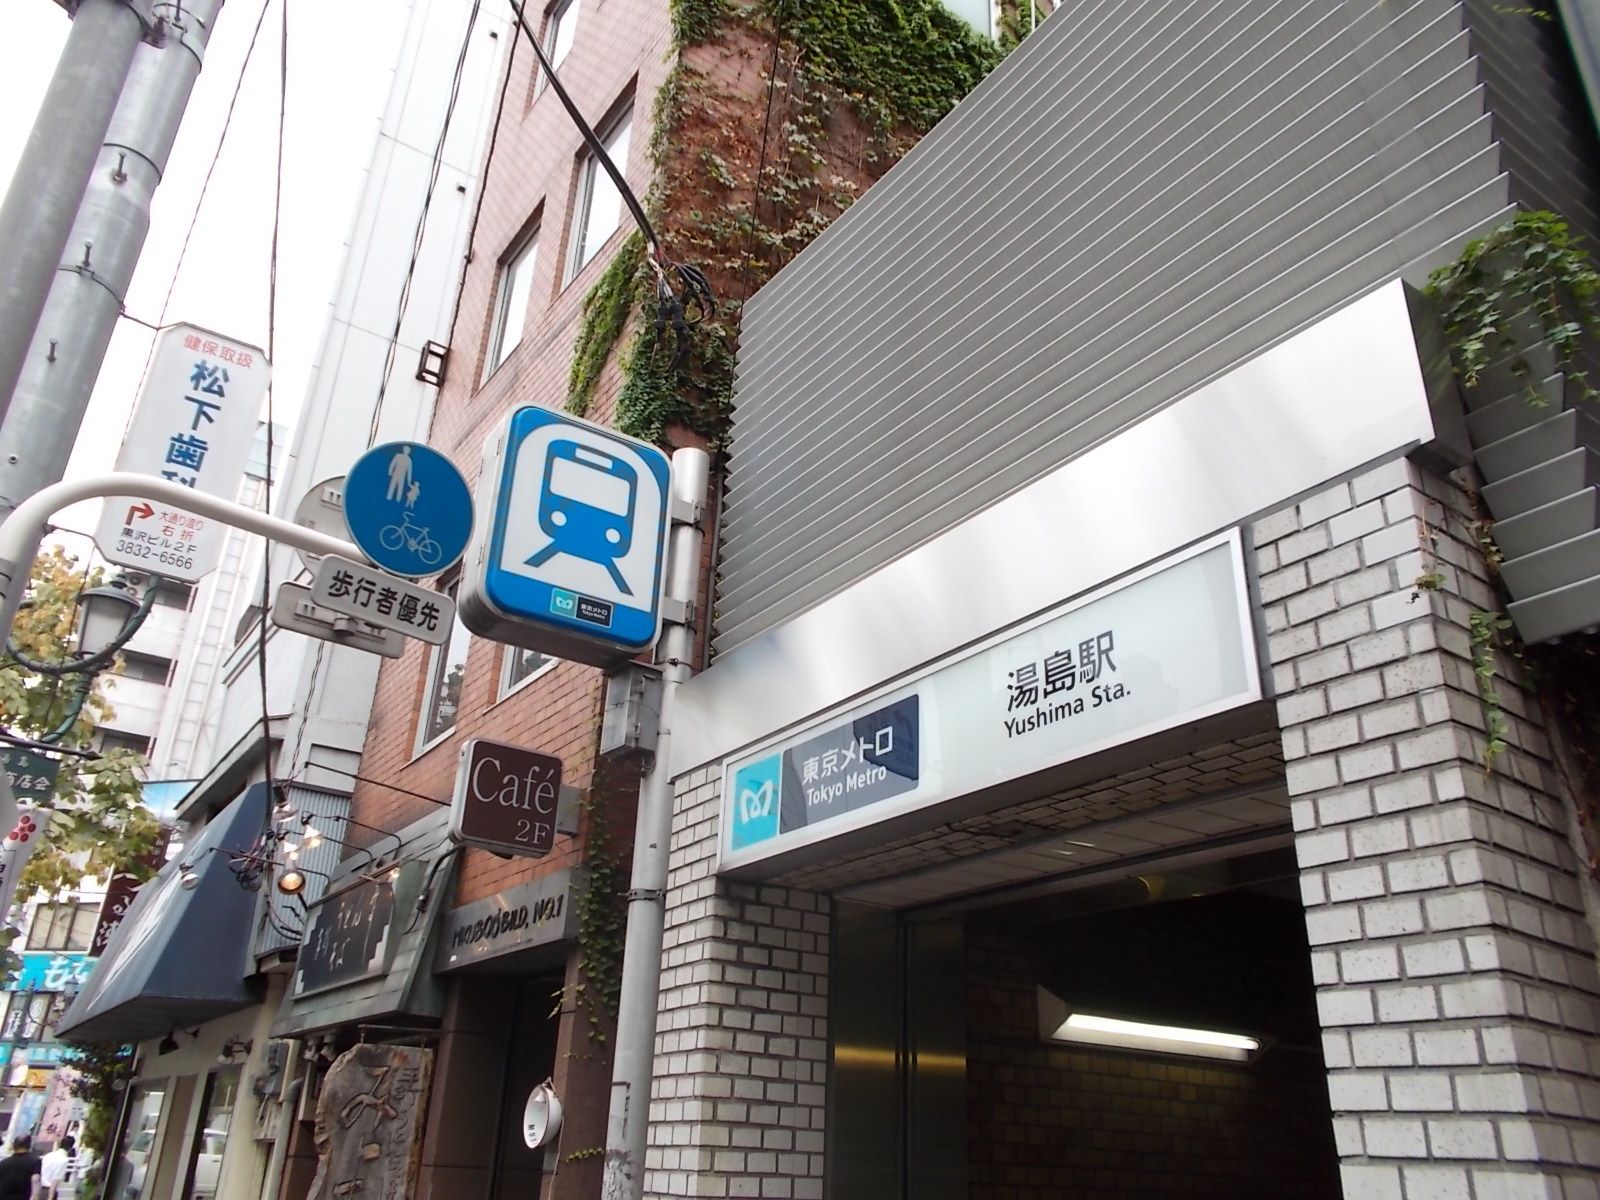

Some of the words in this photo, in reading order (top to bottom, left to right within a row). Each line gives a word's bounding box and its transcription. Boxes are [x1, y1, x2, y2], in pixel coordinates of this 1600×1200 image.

[183, 334, 253, 368] 健保取扱
[116, 540, 192, 569] 3832-6566
[328, 569, 440, 632] 歩行者優先
[1007, 630, 1117, 712] 湯島駅
[1004, 697, 1084, 738] Yushima
[1091, 683, 1131, 708] Sta.
[802, 725, 893, 786] 東京メトロ
[473, 757, 555, 814] Café
[806, 782, 843, 807] Tokyo
[846, 765, 887, 793] Metro
[515, 819, 551, 844] 2F
